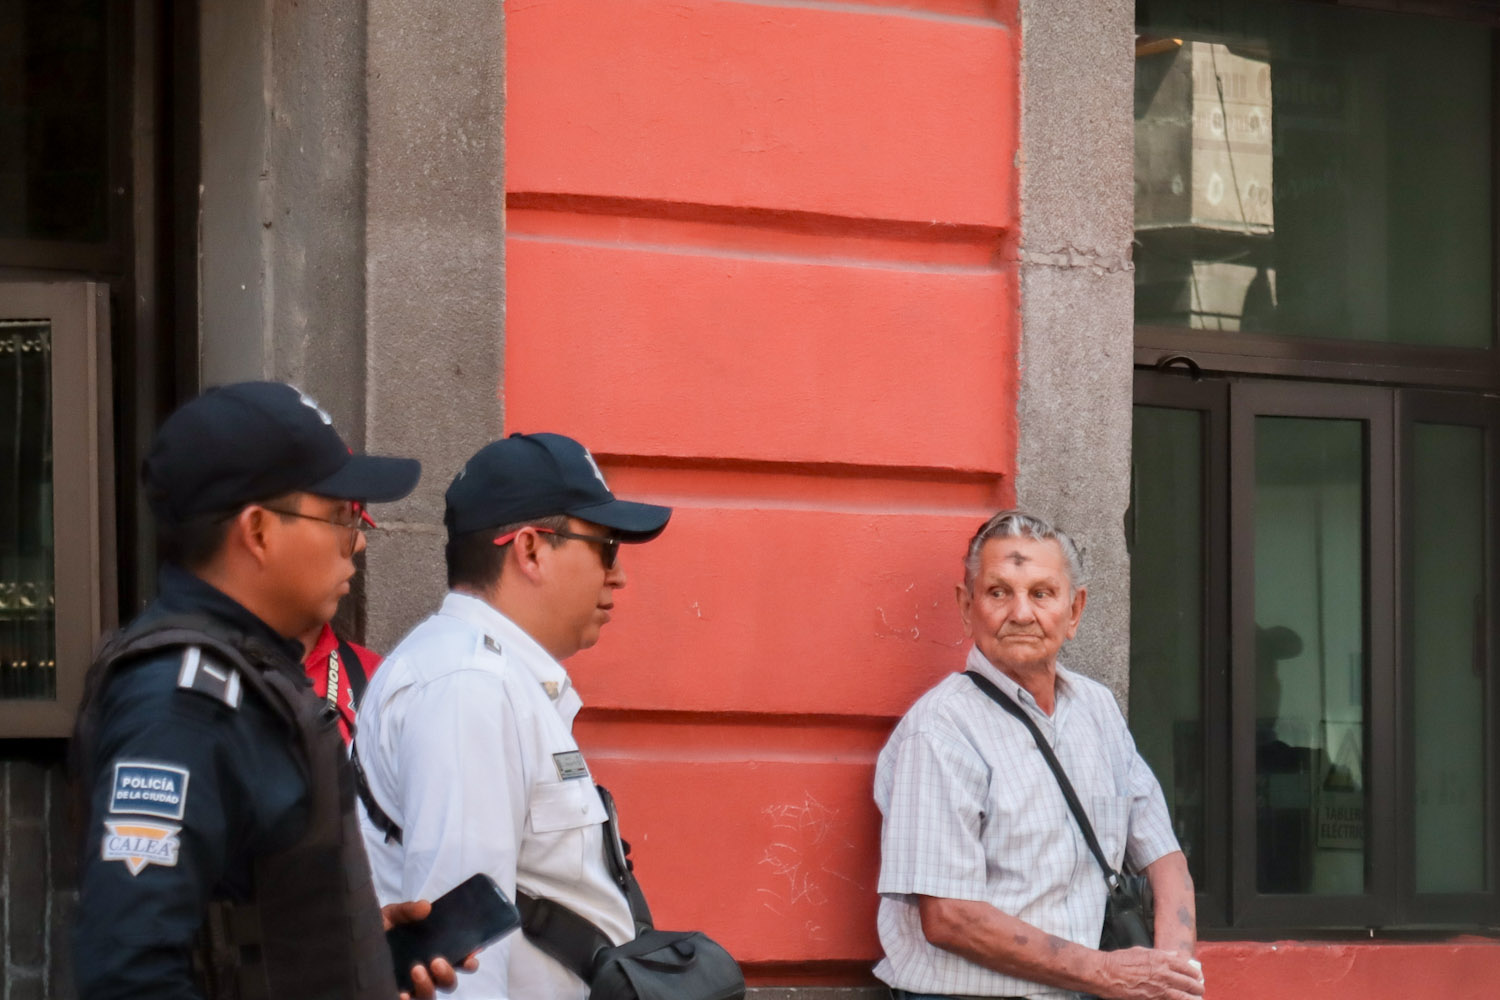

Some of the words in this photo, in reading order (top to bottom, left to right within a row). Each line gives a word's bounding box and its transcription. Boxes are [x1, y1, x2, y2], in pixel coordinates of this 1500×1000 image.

[122, 776, 175, 792] POLICÍA
[116, 790, 129, 800] DE
[129, 790, 141, 800] LA
[142, 792, 179, 804] CIUDAD
[109, 837, 170, 857] CALEA
